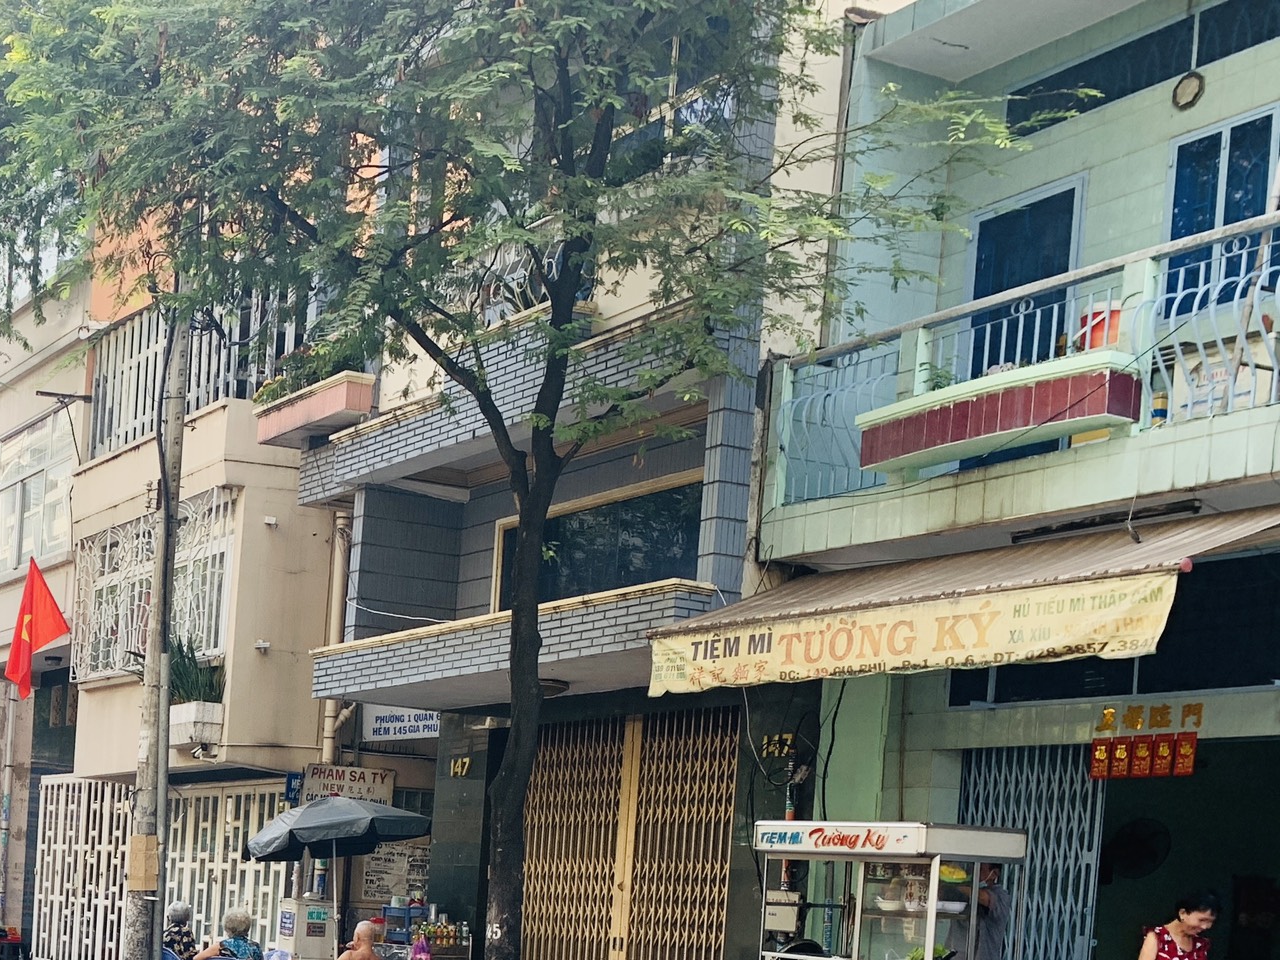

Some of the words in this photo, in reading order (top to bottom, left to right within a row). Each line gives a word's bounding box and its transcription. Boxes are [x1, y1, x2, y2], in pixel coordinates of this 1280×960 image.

[1013, 597, 1030, 618] HỦ
[1035, 594, 1065, 616] TIẾU
[777, 617, 918, 666] TƯỜNG
[932, 600, 1002, 652] KÝ
[691, 632, 740, 664] TIỆM
[748, 627, 773, 655] MÌ
[407, 714, 411, 722] 1
[393, 725, 408, 735] 145
[408, 725, 420, 734] GIA
[349, 770, 366, 783] SA
[450, 757, 470, 777] 147
